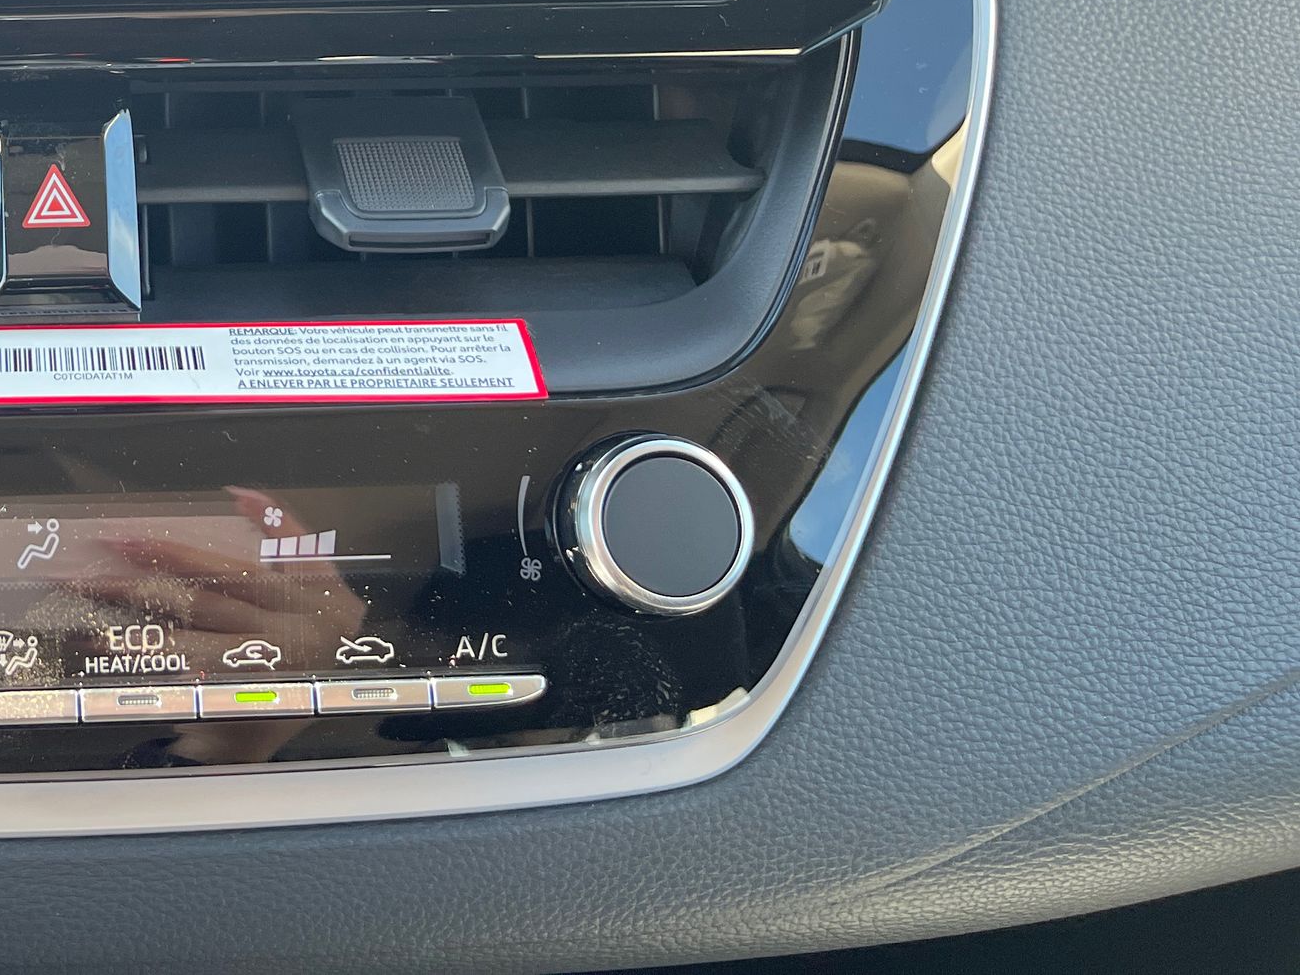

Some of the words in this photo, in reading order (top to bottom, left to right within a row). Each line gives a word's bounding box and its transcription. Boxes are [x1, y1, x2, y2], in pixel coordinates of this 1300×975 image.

[229, 327, 297, 336] REMARQUE:
[298, 327, 328, 335] Votre
[330, 326, 375, 334] véhicule
[378, 326, 403, 335] peut
[404, 325, 468, 333] transmettre
[496, 324, 508, 332] fil
[230, 337, 251, 345] des
[254, 337, 303, 345] données
[323, 336, 388, 344] localisation
[408, 335, 462, 344] appuyant
[483, 334, 494, 342] le
[232, 347, 275, 355] bouton
[277, 346, 301, 355] SOS
[360, 346, 375, 354] de
[378, 345, 428, 353] collision.
[431, 345, 457, 353] Pour
[460, 344, 498, 352] arrêter
[500, 344, 511, 352] la
[234, 357, 311, 366] transmission,
[313, 356, 374, 365] demandez
[376, 356, 384, 364] à
[404, 356, 438, 365] agent
[439, 355, 456, 363] via
[458, 355, 487, 363] SOS.
[235, 368, 260, 376] Voir
[238, 379, 247, 389] A
[250, 378, 304, 389] ENLEVER
[307, 378, 331, 389] PAR
[334, 378, 348, 388] LE
[350, 377, 437, 388] PROPRIETAIRE
[439, 377, 515, 388] SEULEMENT
[109, 624, 165, 651] ECO
[456, 632, 508, 661] A/C
[85, 653, 190, 674] HEAT/COOL
